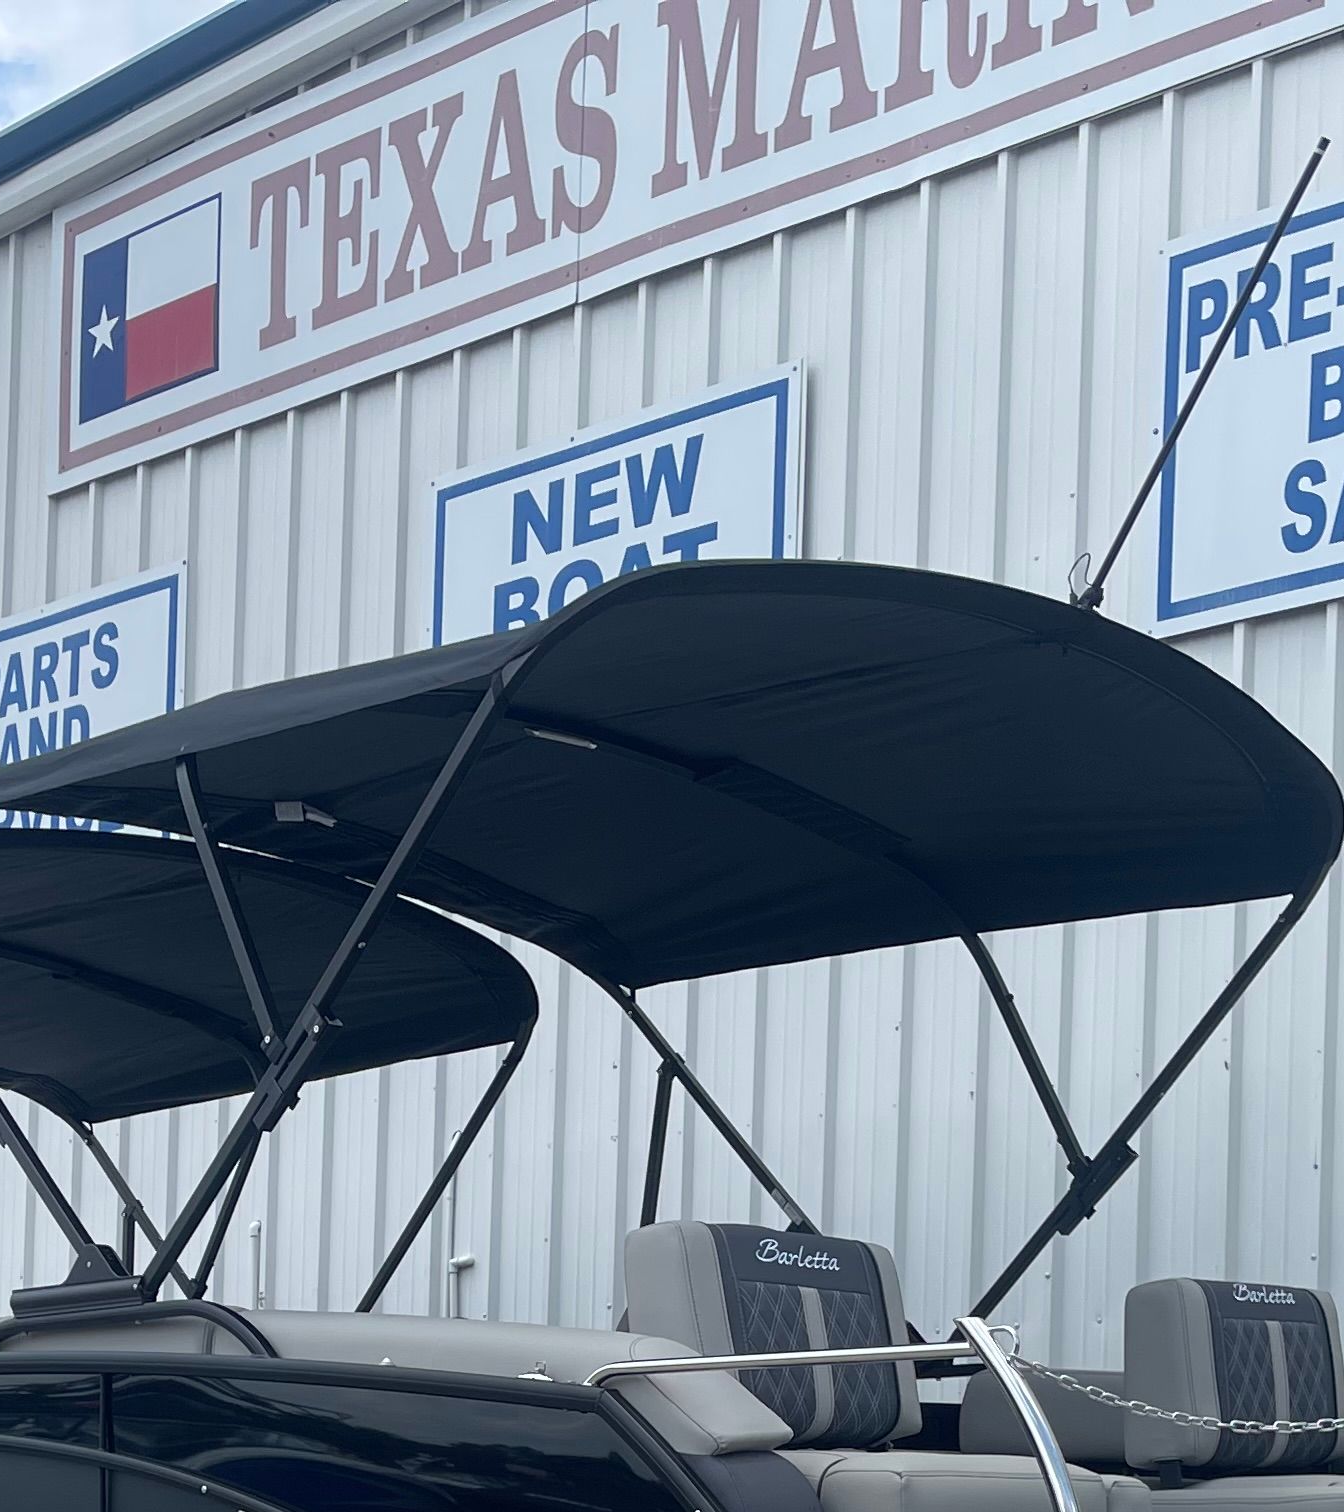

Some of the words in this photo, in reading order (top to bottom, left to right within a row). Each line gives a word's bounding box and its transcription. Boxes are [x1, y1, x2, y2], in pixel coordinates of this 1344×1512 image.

[250, 23, 620, 351] TEXAS
[511, 433, 704, 565] NEW
[0, 704, 91, 767] AND
[755, 1238, 841, 1271] Barletta
[1233, 1283, 1296, 1304] Barletta
